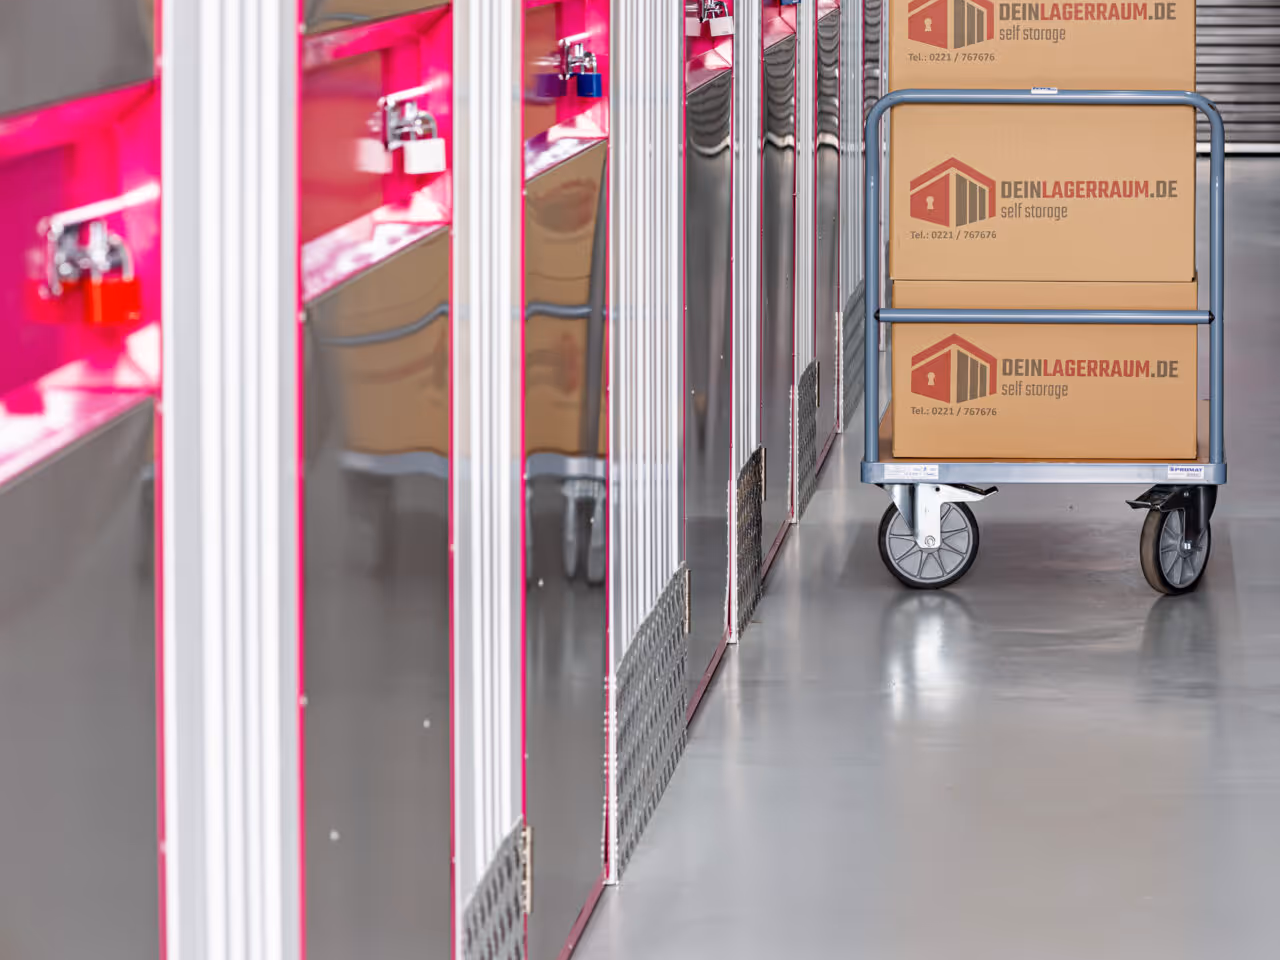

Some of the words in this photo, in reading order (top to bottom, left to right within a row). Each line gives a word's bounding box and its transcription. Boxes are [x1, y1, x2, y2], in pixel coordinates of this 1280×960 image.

[999, 2, 1177, 21] DEINLAGERRAUM.DE
[999, 24, 1021, 41] self
[1023, 26, 1066, 43] storage
[908, 52, 927, 62] Tel.:
[929, 53, 952, 62] 0221
[953, 52, 959, 63] /
[961, 53, 996, 62] 767676
[1000, 180, 1178, 199] DEINLAGERRAUM.DE
[1000, 203, 1023, 219] self
[1024, 204, 1068, 221] storage
[910, 230, 929, 240] Tel.:
[931, 231, 954, 240] 0221
[955, 230, 961, 241] /
[963, 231, 997, 240] 767676
[1002, 358, 1179, 378] DEINLAGERRAUM.DE
[1001, 381, 1023, 396] self
[1025, 382, 1069, 399] storage
[910, 406, 929, 416] Tel.:
[931, 407, 954, 416] 0221
[955, 406, 962, 417] /
[963, 407, 997, 416] 767676
